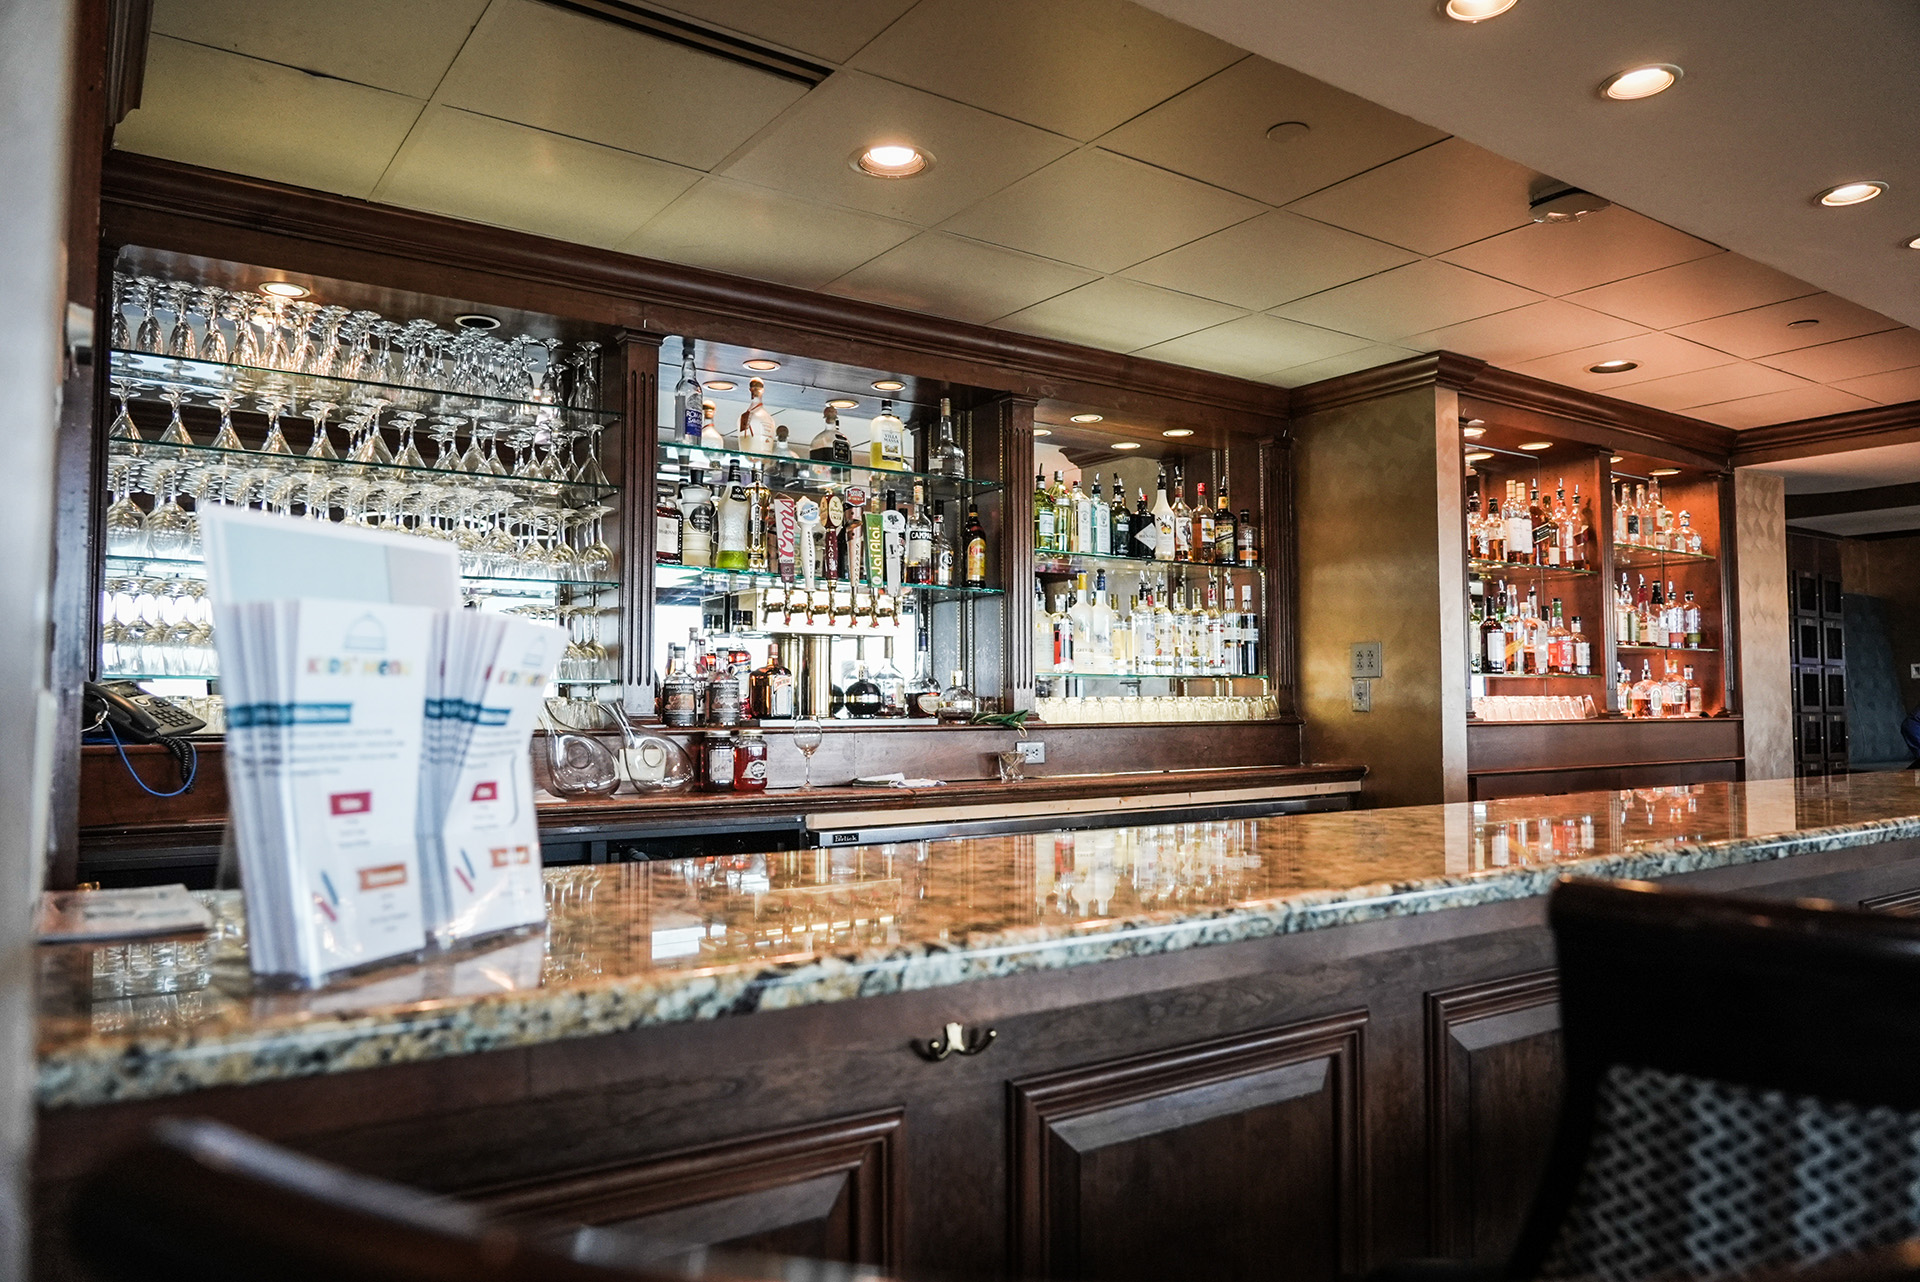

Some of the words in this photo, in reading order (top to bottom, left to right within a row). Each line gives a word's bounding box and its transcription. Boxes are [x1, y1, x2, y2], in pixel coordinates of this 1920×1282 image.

[778, 500, 794, 557] Coors
[869, 526, 881, 551] Alai
[870, 554, 882, 575] Jai
